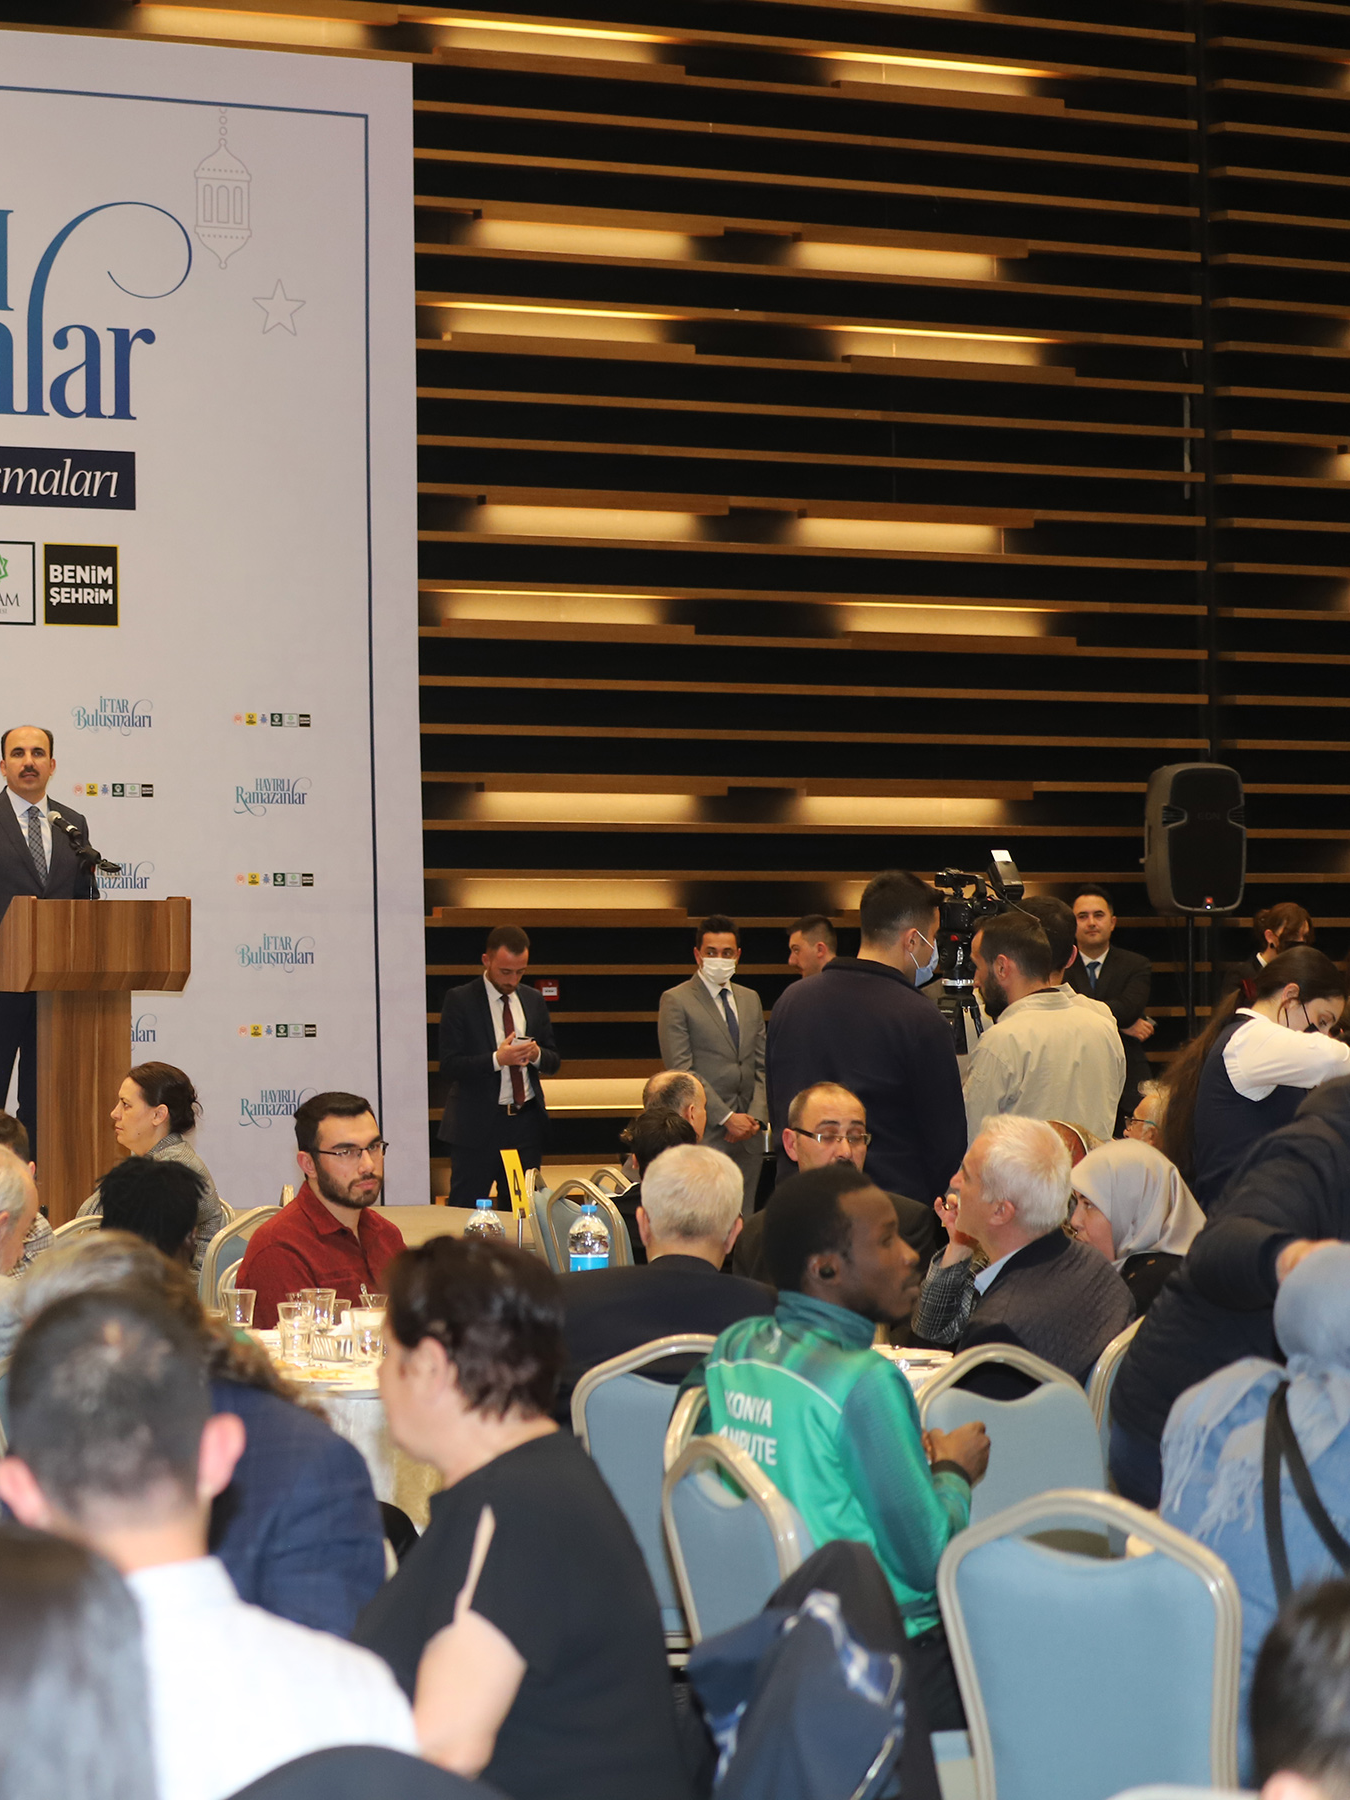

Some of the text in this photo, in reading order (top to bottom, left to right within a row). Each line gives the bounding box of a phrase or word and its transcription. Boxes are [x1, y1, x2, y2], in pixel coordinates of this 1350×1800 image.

[49, 564, 113, 584] BENİM
[99, 695, 129, 713] İFTAR
[255, 778, 290, 792] HAYIRLI
[233, 776, 312, 817] Ramazanlar
[263, 933, 292, 950] İFTAR
[260, 1089, 296, 1103] HAYIRLI
[513, 1169, 522, 1202] 4
